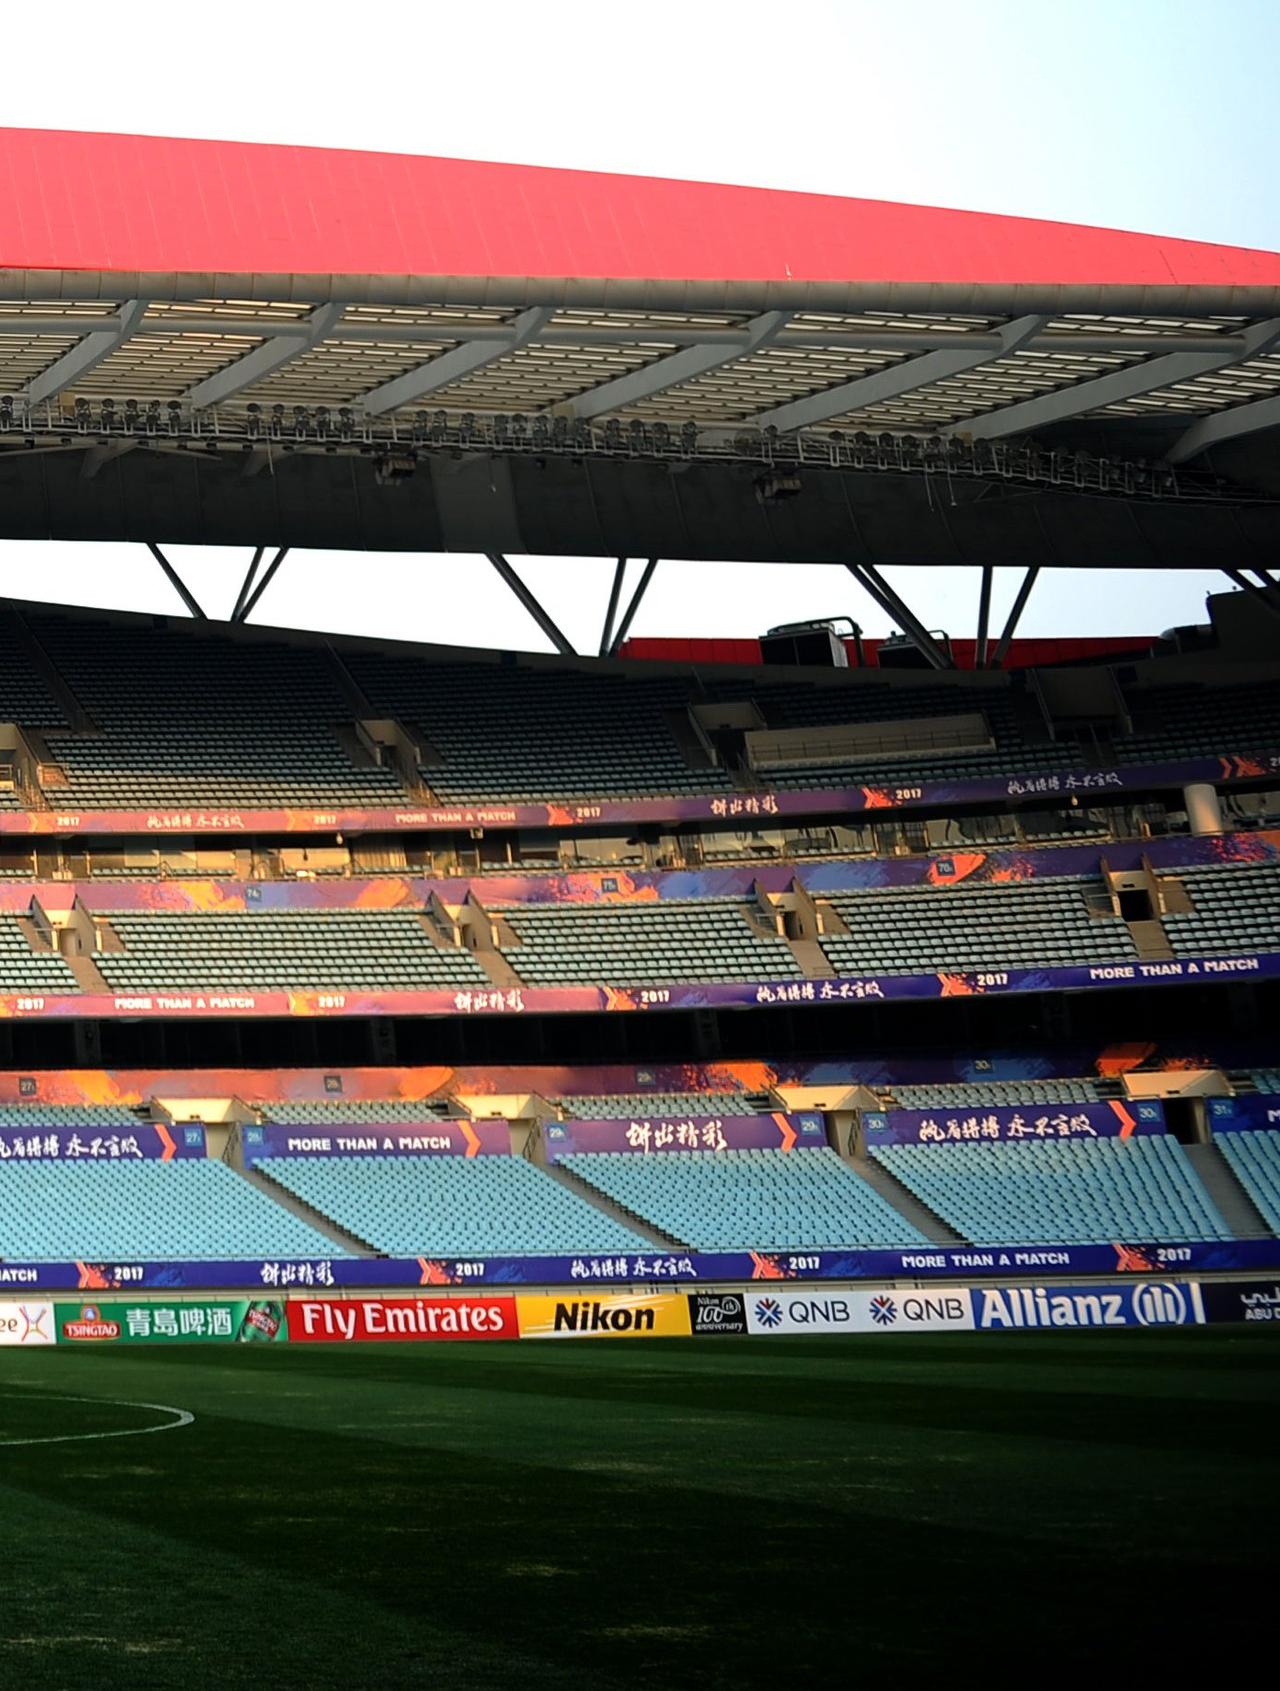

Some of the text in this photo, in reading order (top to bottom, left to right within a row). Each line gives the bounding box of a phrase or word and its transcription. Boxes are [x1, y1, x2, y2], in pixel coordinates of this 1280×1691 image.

[896, 789, 921, 799] 2017
[1090, 959, 1258, 979] MORE THAN A MATCH
[977, 974, 1007, 985] 2017
[319, 996, 344, 1007] 2017
[641, 990, 669, 1002] 2017
[18, 998, 44, 1009] 2017
[115, 998, 254, 1008] MORE THAN A MATCH
[288, 1137, 450, 1150] MORE THAN A MATCH
[902, 1253, 1069, 1267] MORE THAN A MATCH
[1158, 1248, 1191, 1261] 2017
[456, 1263, 484, 1275] 2017
[790, 1257, 819, 1269] 2017
[115, 1267, 143, 1280] 2017
[789, 1301, 849, 1323] QNB
[904, 1299, 964, 1321] QNB
[978, 1284, 1125, 1327] Allianz
[303, 1304, 355, 1339] Fly
[363, 1301, 503, 1332] Emirates
[554, 1302, 654, 1331] Nikon
[66, 1324, 118, 1336] TSINGTAO
